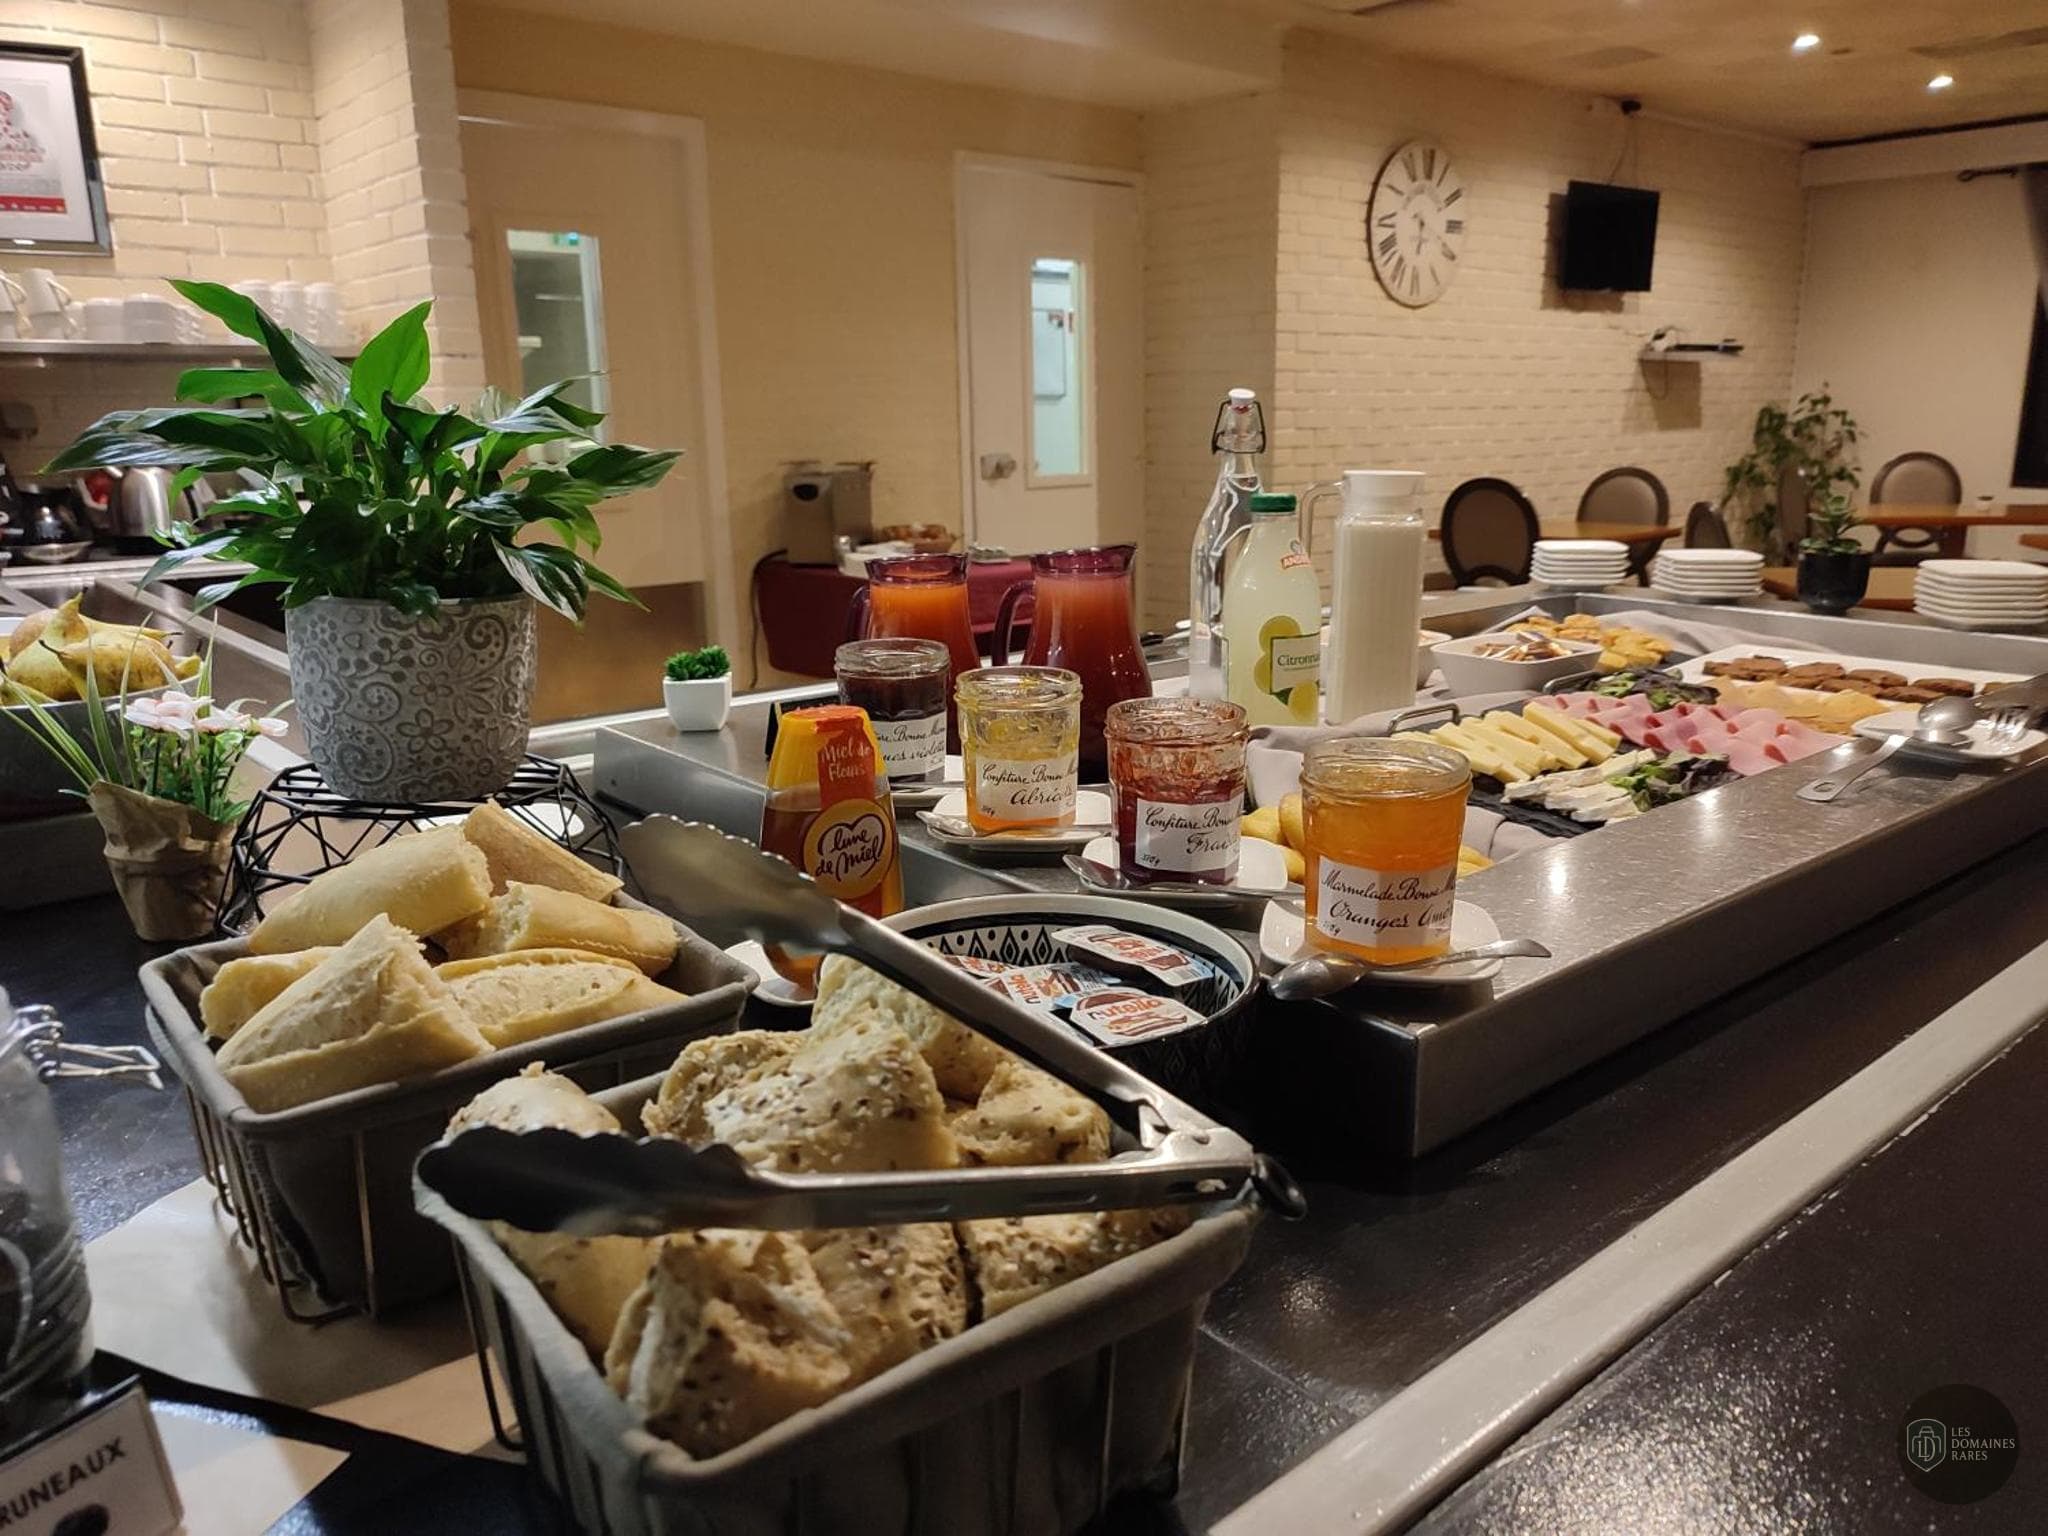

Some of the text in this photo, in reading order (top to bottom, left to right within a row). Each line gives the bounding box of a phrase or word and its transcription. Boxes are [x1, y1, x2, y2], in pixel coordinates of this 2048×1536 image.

[982, 762, 1030, 786] Confiture
[1144, 806, 1201, 832] Confiture
[1321, 869, 1396, 901] Marmelade
[1329, 899, 1409, 934] Oranges
[1088, 999, 1164, 1021] nutella
[0, 1436, 126, 1531] RUNEAUX
